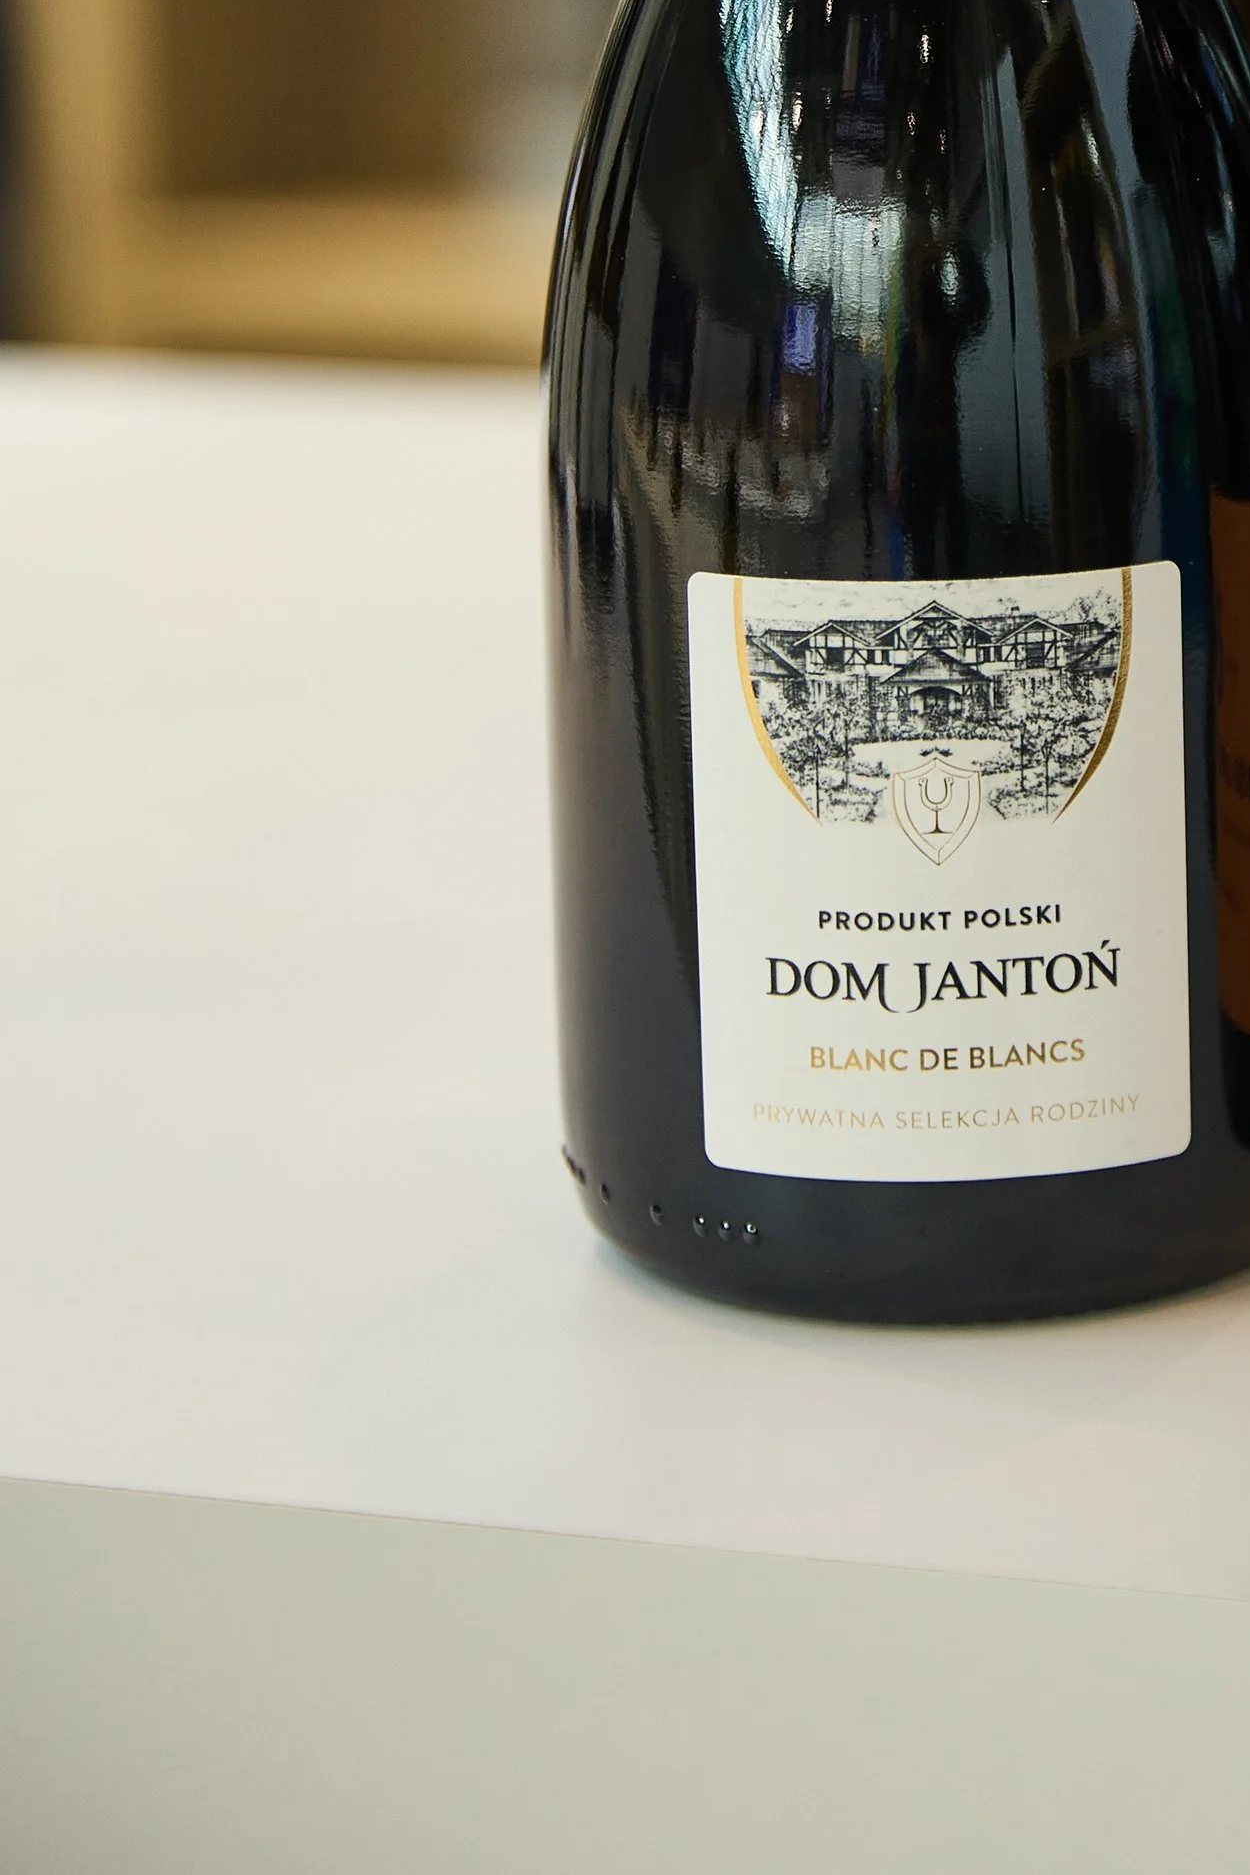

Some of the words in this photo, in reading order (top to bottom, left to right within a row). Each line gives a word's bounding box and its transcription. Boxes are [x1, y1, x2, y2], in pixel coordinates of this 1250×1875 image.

[817, 909, 953, 932] PRODUKT
[963, 903, 1062, 929] POLSKI
[765, 956, 898, 1013] DOM
[907, 938, 1122, 1013] JANTOŃ
[809, 1046, 909, 1073] BLANC
[919, 1047, 960, 1071] DE
[968, 1038, 1086, 1070] BLANCS
[753, 1103, 886, 1129] PRYWATNA
[895, 1106, 1020, 1130] SELEKCJA
[1030, 1093, 1141, 1124] RODZINY
